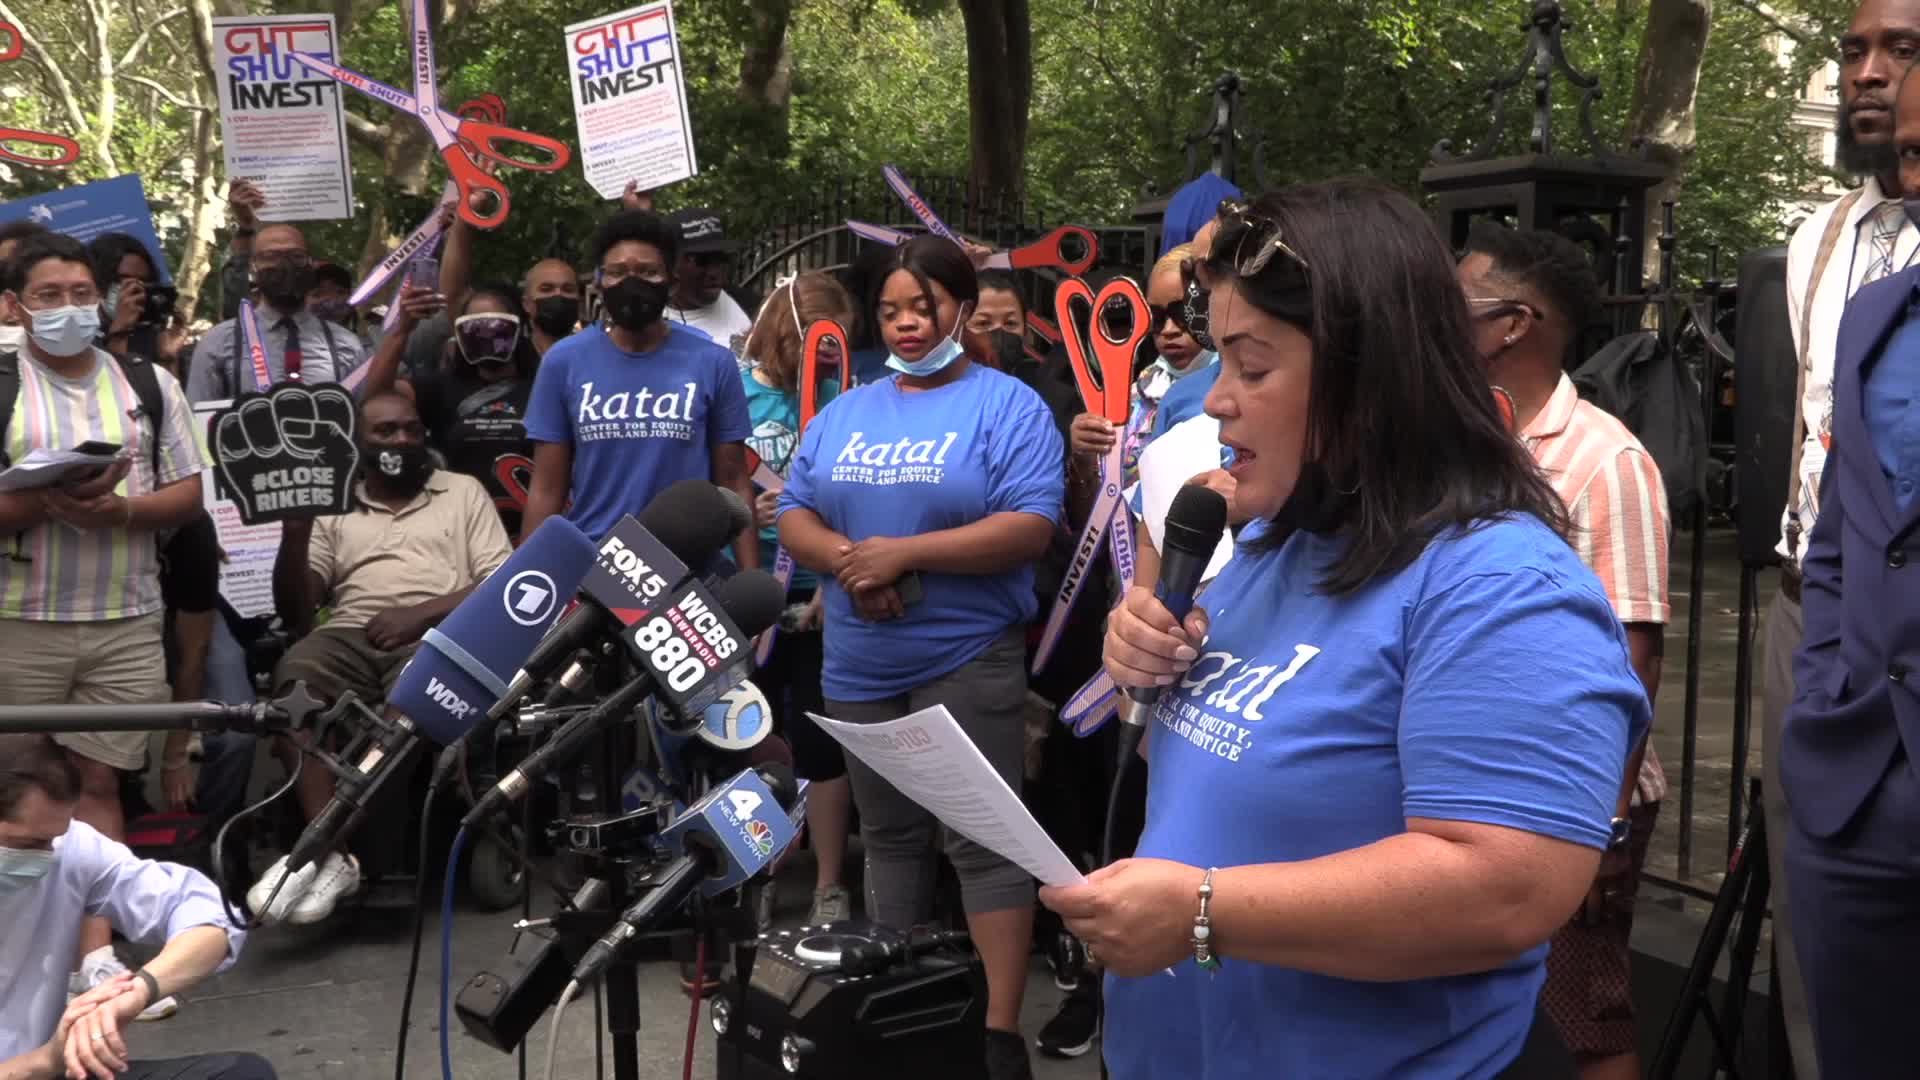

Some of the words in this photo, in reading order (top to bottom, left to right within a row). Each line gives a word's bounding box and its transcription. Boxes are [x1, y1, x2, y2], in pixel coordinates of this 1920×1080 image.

[225, 24, 329, 54] CUT
[575, 11, 666, 54] CUT
[417, 30, 430, 84] INVEST!
[577, 33, 670, 79] SHUT
[229, 74, 336, 110] INVEST
[332, 69, 364, 88] CUT!
[368, 83, 408, 106] SHUT!
[578, 58, 673, 105] INVEST
[384, 231, 427, 270] INVEST!
[578, 382, 696, 422] katal
[580, 422, 620, 433] CENTER
[624, 421, 647, 430] FOR
[625, 429, 648, 439] AND
[649, 429, 691, 440] JUSTICE
[836, 431, 958, 466] katal
[252, 466, 336, 492] #CLOSE
[833, 465, 874, 476] CENTER
[878, 468, 897, 477] FOR
[876, 477, 897, 485] AND
[898, 473, 941, 484] JUSTICE
[256, 487, 335, 512] RIKERS
[600, 536, 653, 586] FOX
[642, 574, 668, 597] 5
[1060, 526, 1100, 604] INVEST!
[1115, 520, 1133, 580] SHUT!
[620, 576, 651, 606] YORK
[666, 607, 717, 667] NEWSRADIO
[678, 591, 738, 659] WCBS
[634, 616, 706, 692] 880
[425, 677, 470, 720] WDR
[1180, 643, 1321, 721] atal
[1174, 718, 1192, 738] AND
[1189, 727, 1243, 762] JUSTICE
[1180, 702, 1201, 723] FOR
[1198, 713, 1253, 749] EQUITY,
[728, 789, 763, 821] 4
[717, 800, 740, 827] NEW
[738, 827, 764, 862] YORK
